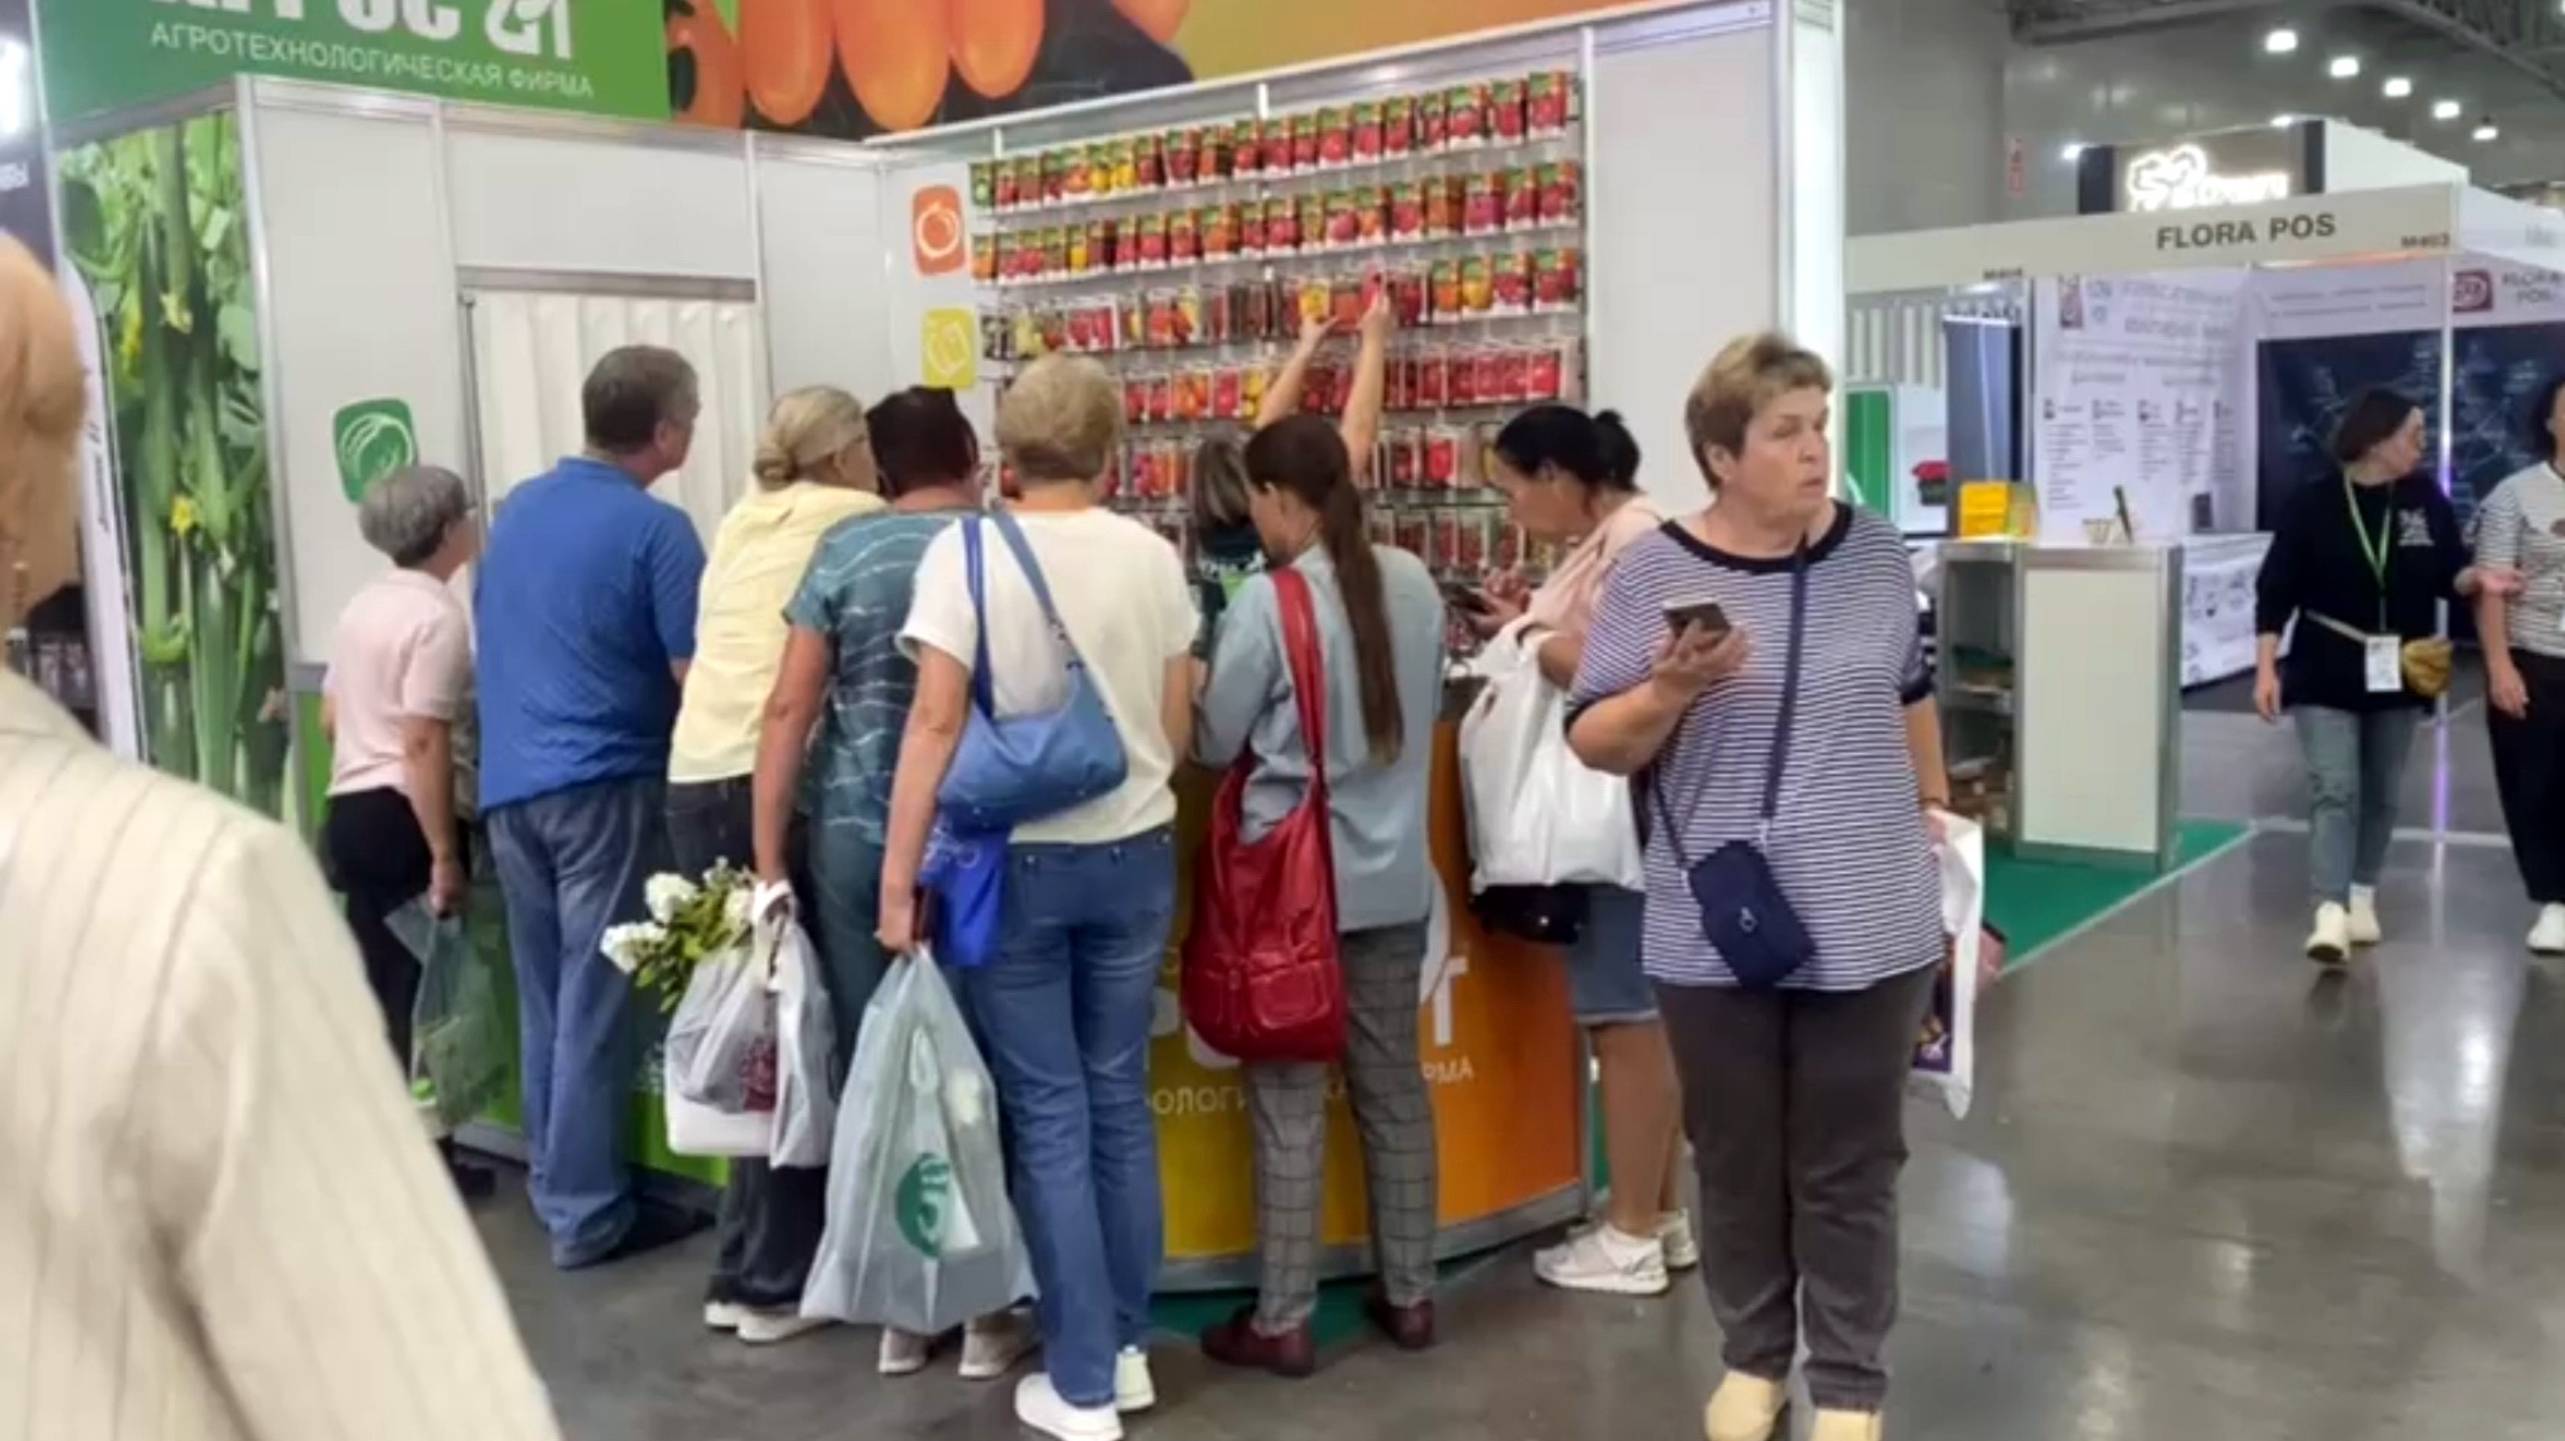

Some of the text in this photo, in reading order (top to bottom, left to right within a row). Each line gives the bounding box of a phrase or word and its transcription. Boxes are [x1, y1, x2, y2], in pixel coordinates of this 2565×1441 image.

[152, 22, 502, 89] АГРОТЕХНОЛОГИЧЕСКАЯ
[2155, 212, 2338, 250] FLORA POS
